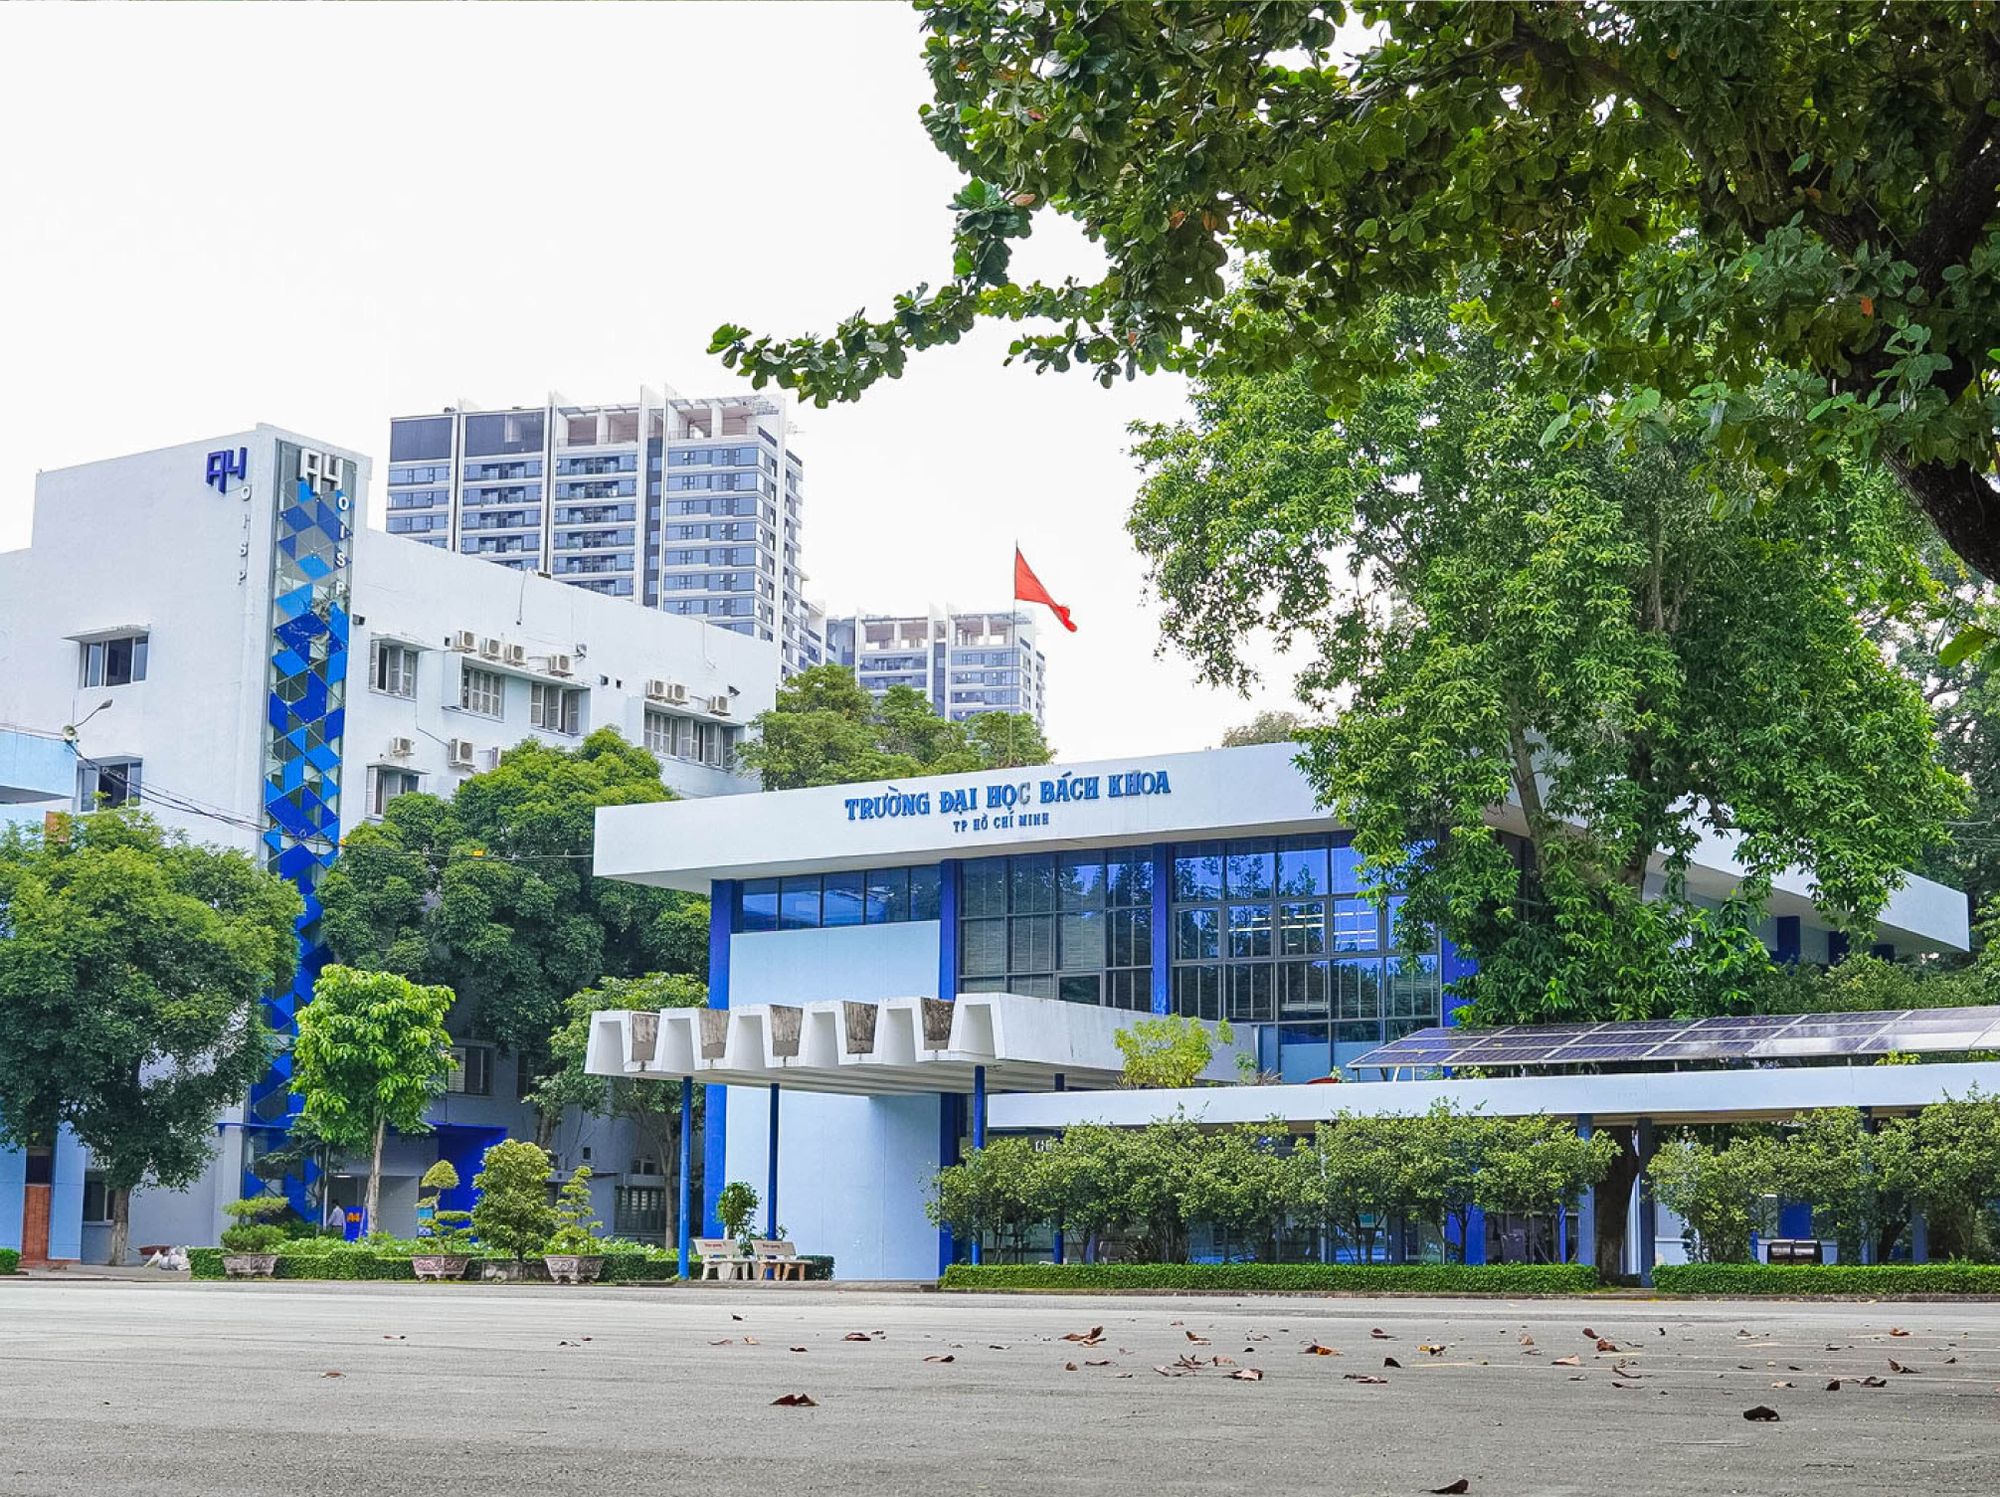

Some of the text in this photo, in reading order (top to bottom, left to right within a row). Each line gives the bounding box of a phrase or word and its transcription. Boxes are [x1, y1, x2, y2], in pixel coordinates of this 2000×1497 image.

[206, 447, 248, 494] A4
[300, 448, 343, 496] A4
[334, 496, 350, 594] OISP
[845, 770, 1171, 820] TRƯỜNG ĐẠI HỌC BÁCH KHOA
[953, 820, 968, 833] TP
[993, 810, 1014, 829] CHÍ
[1018, 812, 1049, 827] MINH
